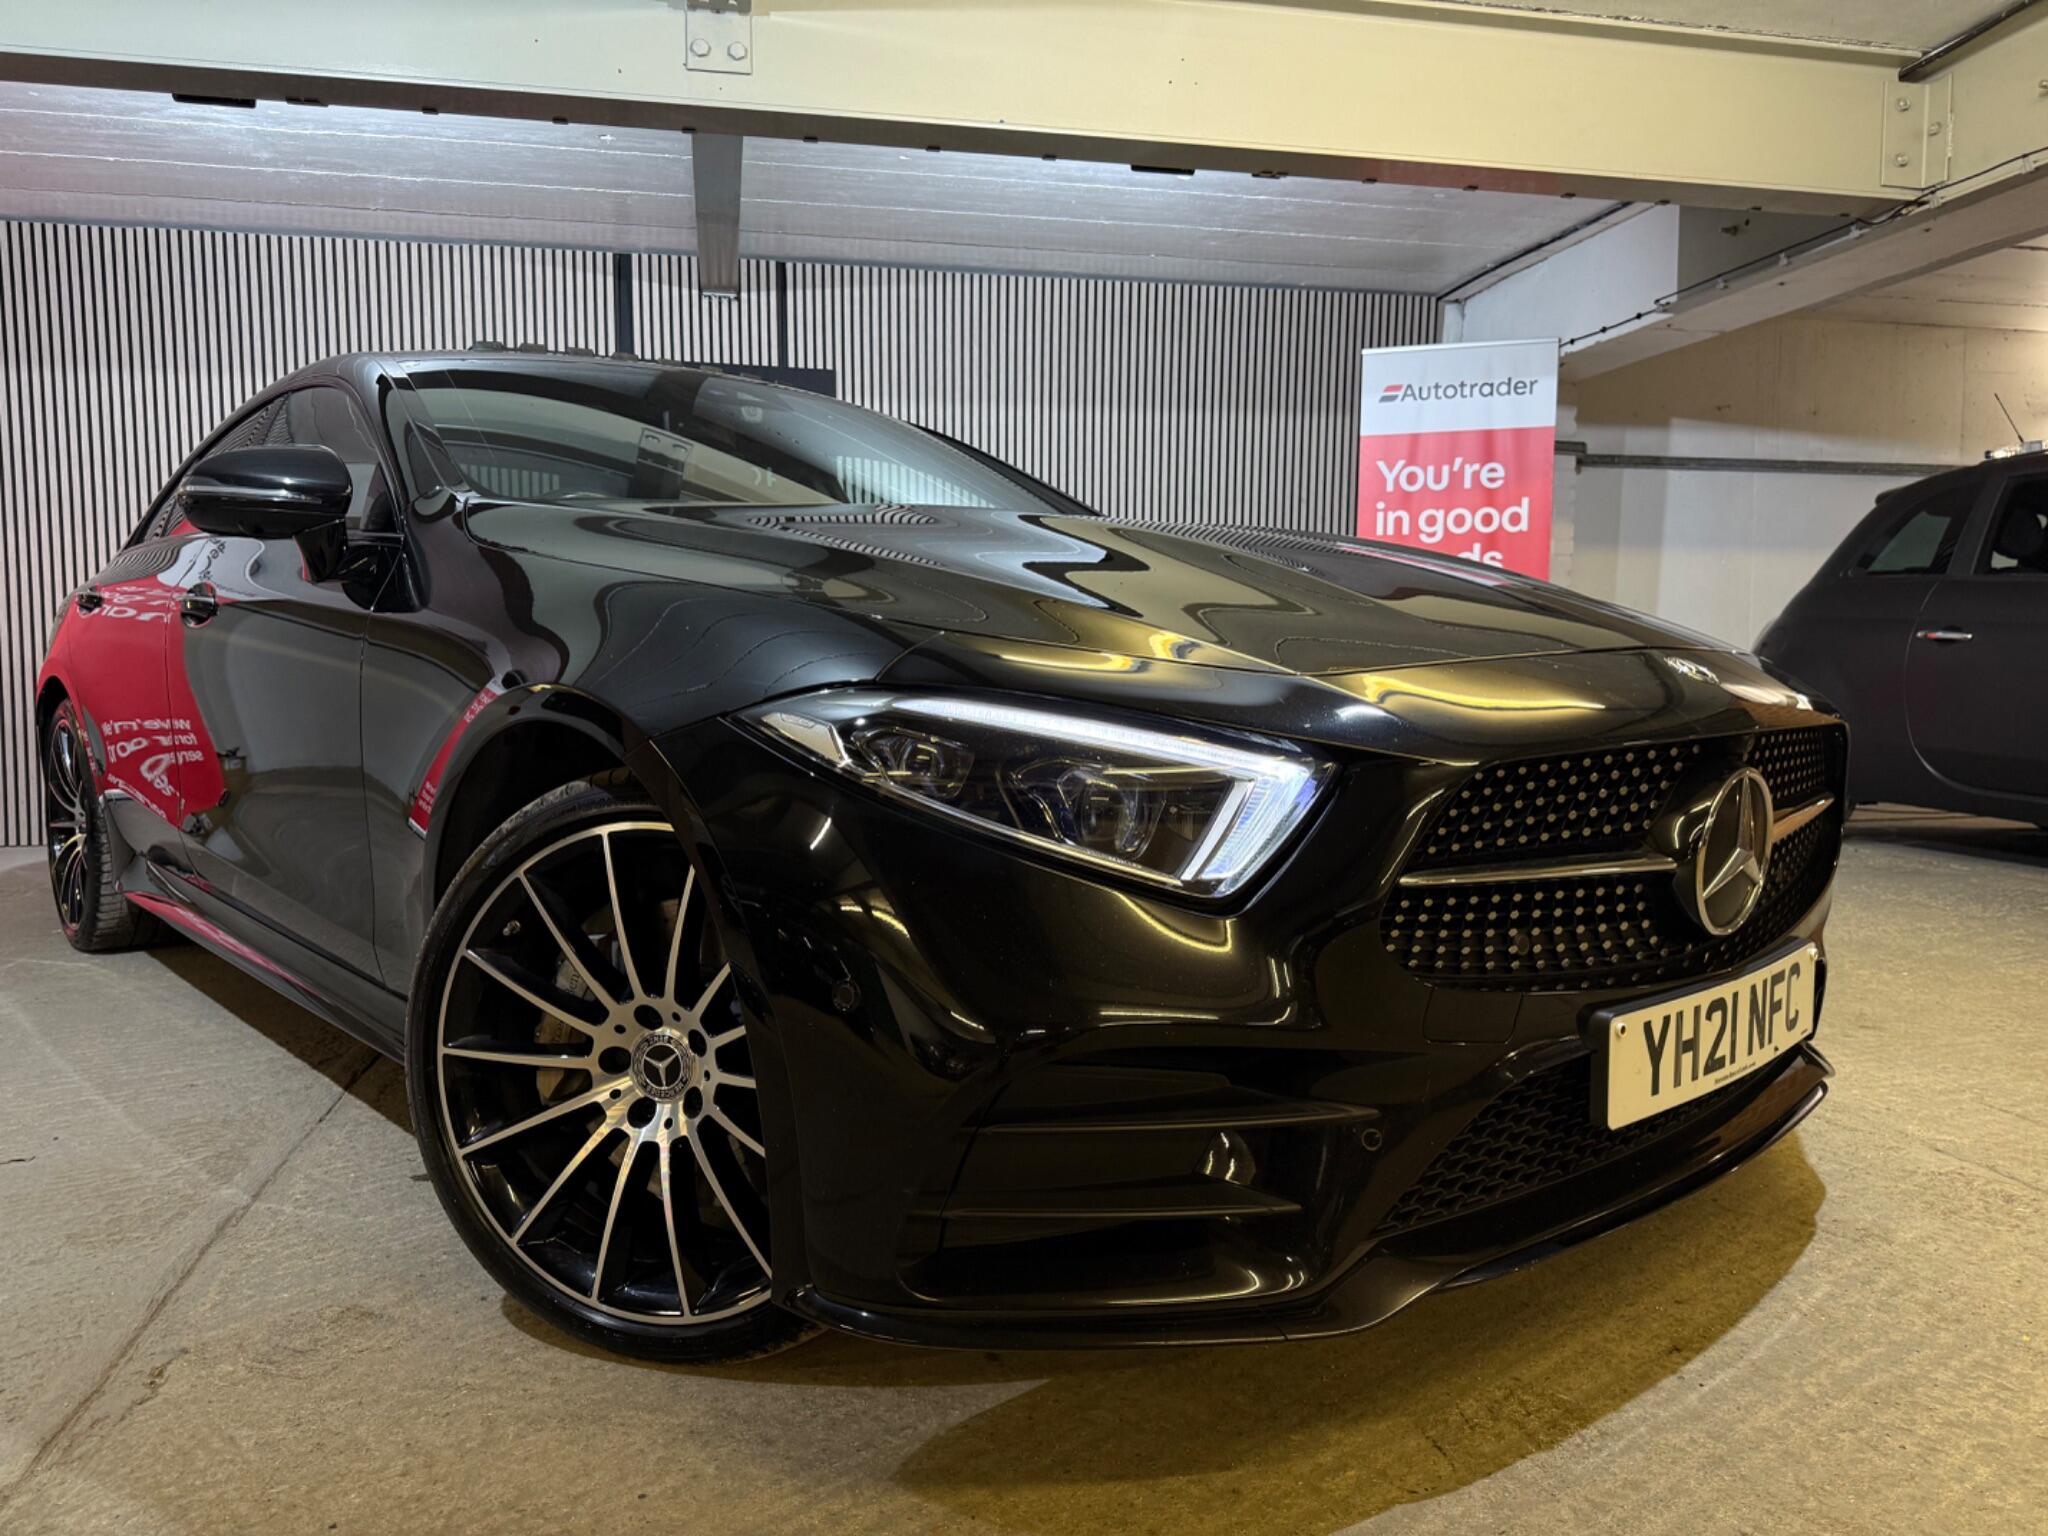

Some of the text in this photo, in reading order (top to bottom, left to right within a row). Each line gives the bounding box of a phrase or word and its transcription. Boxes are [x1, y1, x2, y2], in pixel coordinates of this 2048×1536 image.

[1400, 377, 1538, 402] Autotrader
[1376, 497, 1529, 543] in good
[1643, 961, 1801, 1097] YH21 NFC
